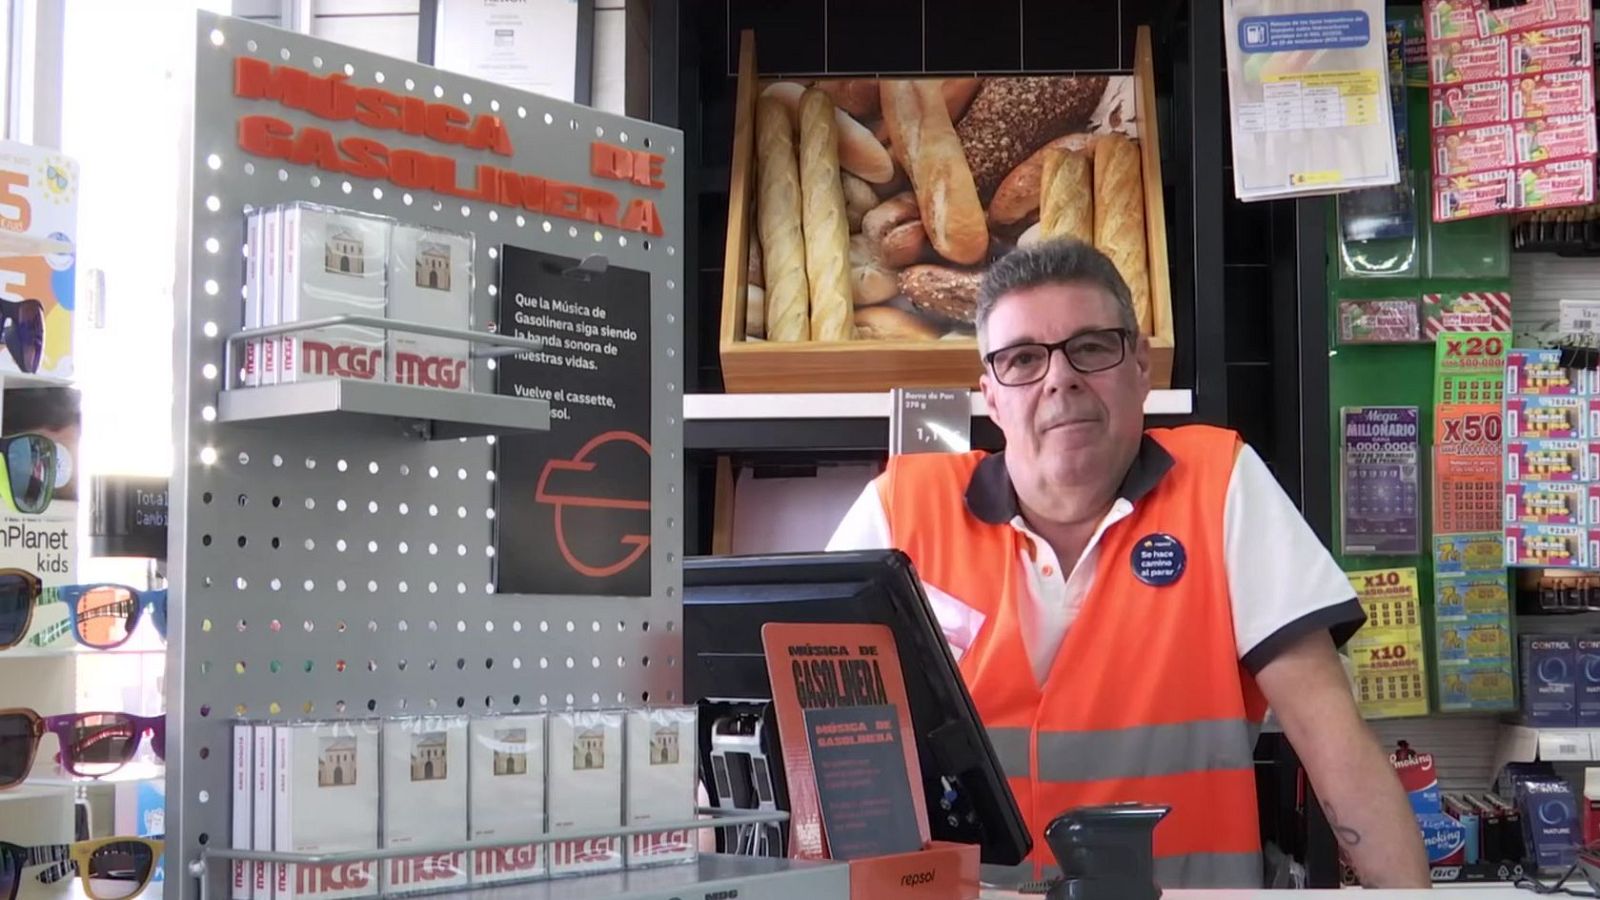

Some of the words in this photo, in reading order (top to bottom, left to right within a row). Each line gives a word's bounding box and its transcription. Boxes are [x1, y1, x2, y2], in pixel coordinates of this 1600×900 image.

[234, 55, 511, 157] MÚSICA
[591, 141, 666, 190] DE
[237, 115, 664, 237] GASOLINERA
[515, 293, 538, 311] Que
[539, 296, 550, 311] la
[552, 299, 590, 317] Música
[592, 305, 606, 318] de
[515, 311, 574, 332] Gasolinera
[576, 321, 598, 338] siga
[601, 325, 637, 341] siendo
[527, 331, 562, 348] banda
[564, 336, 602, 354] sonora
[604, 342, 618, 356] de
[565, 353, 598, 370] vidas.
[514, 384, 552, 400] Vuelve
[554, 388, 565, 401] el
[566, 391, 616, 409] cassette,
[549, 406, 571, 420] sol.
[1366, 410, 1398, 424] Mega
[1347, 423, 1416, 437] MILLONARIO
[1443, 414, 1502, 441] x50
[136, 489, 169, 506] Total
[136, 509, 169, 526] Cambi
[0, 523, 69, 550] nPlanet
[37, 551, 69, 573] kids
[1141, 551, 1152, 559] Se
[1153, 550, 1174, 559] hace
[1140, 559, 1173, 568] camino
[1141, 568, 1149, 577] al
[1151, 568, 1175, 578] parar
[1364, 571, 1400, 587] x10
[788, 643, 849, 656] MÚSICA
[859, 645, 879, 656] DE
[1370, 645, 1406, 661] x10
[1532, 640, 1571, 650] CONTROL
[1579, 640, 1600, 650] CONT
[792, 658, 889, 709] GASOLINERA
[1420, 831, 1461, 850] moking
[901, 868, 936, 888] repsol
